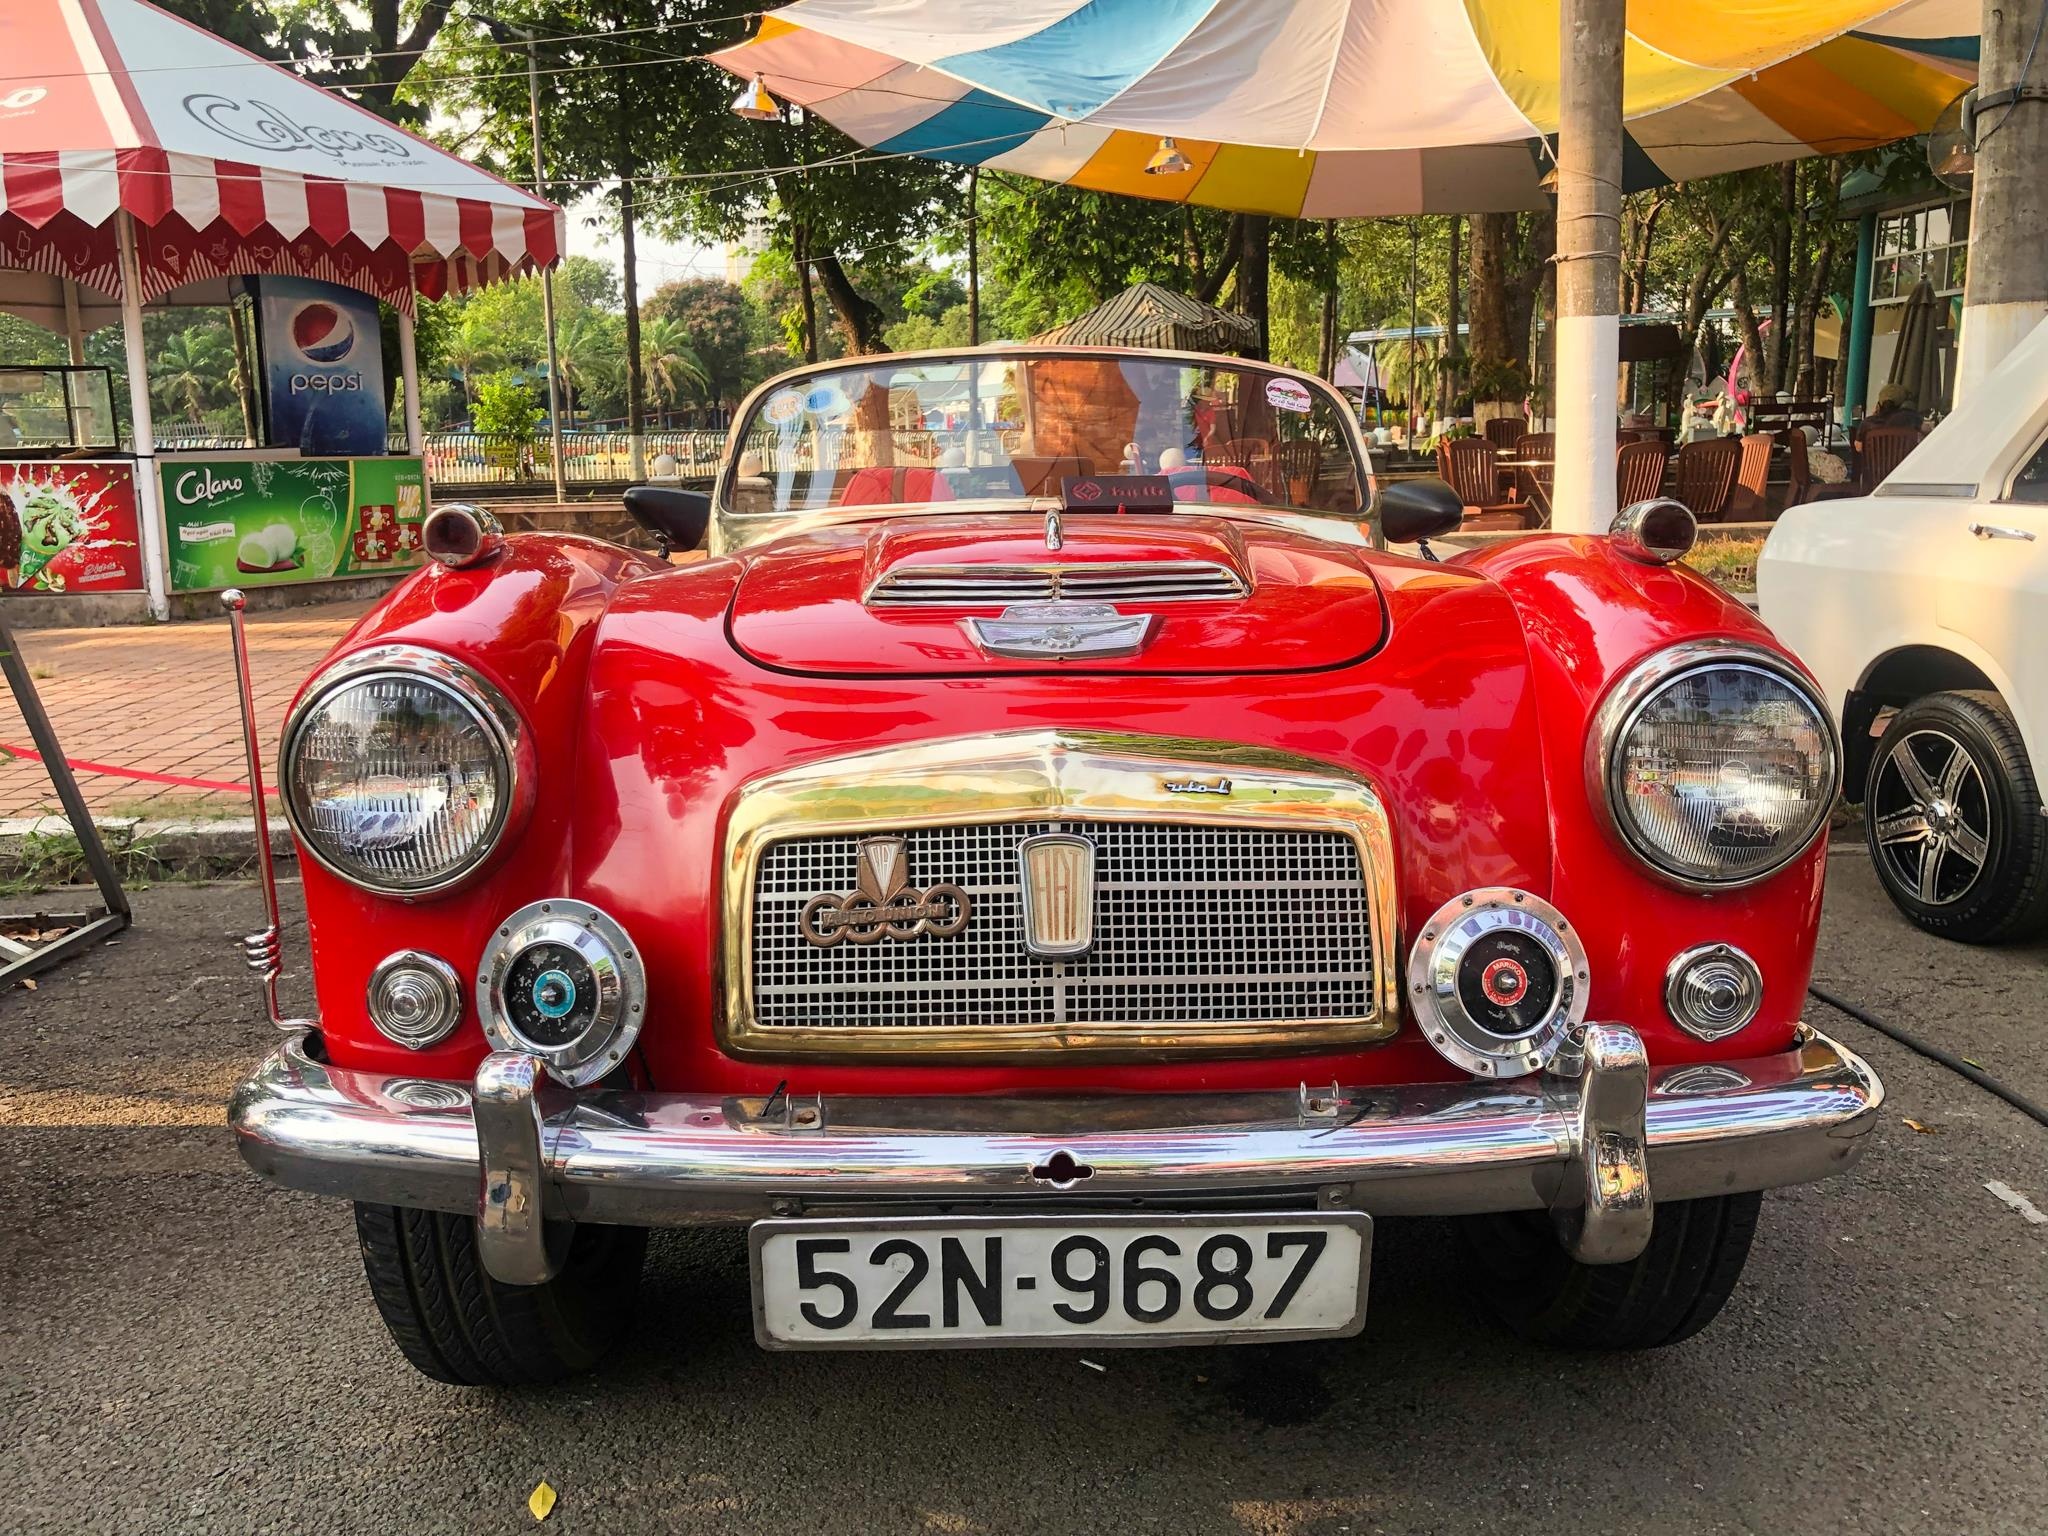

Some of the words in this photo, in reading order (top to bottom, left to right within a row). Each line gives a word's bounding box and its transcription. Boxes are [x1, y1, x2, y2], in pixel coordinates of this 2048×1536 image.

[182, 93, 411, 158] Celano
[290, 371, 365, 396] pepsi
[176, 467, 243, 504] Celano
[823, 909, 876, 926] AUTO
[885, 903, 939, 919] UNION
[1030, 848, 1081, 941] FIAT
[795, 1231, 1328, 1330] 52N-9687
